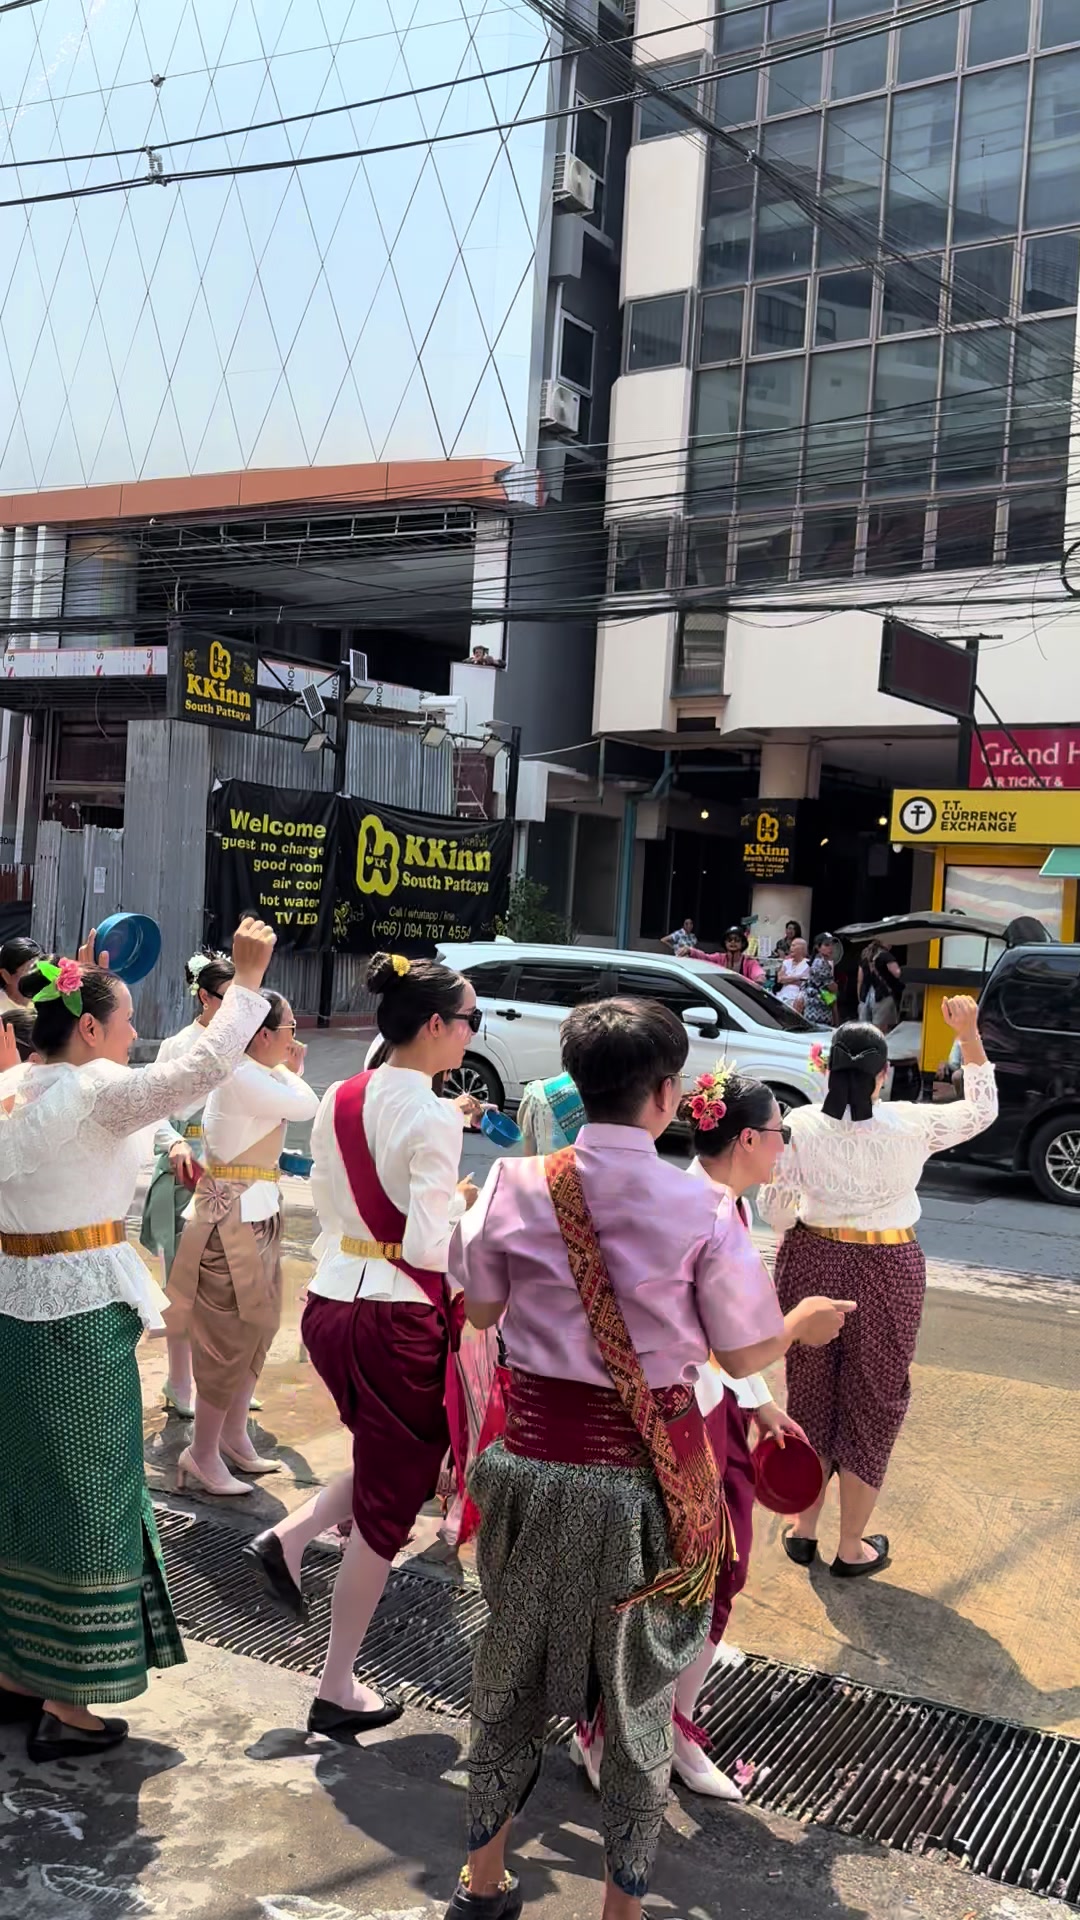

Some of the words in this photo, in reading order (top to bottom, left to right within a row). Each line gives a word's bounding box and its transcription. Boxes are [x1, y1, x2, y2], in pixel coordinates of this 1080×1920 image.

[186, 673, 251, 708] KKinn
[185, 699, 214, 714] South
[216, 704, 251, 721] Pattaya
[981, 742, 1059, 766] Grand
[983, 776, 1005, 788] AR
[1053, 776, 1064, 788] &
[942, 800, 963, 811] T.T.
[229, 808, 327, 839] Welcome
[941, 811, 1017, 822] CURRENCY
[941, 821, 1017, 832] EXCHANGE
[221, 836, 256, 850] guest
[260, 842, 277, 853] no
[281, 842, 325, 859] charge
[403, 834, 491, 872] KKinn
[744, 844, 789, 856] KKinn
[253, 859, 287, 872] good
[289, 862, 323, 873] room
[272, 877, 292, 889] air
[296, 878, 322, 891] cool
[401, 871, 441, 890] South
[444, 876, 489, 895] Pattaya
[260, 892, 280, 906] hot
[284, 895, 320, 908] water
[274, 911, 293, 925] TV
[296, 912, 318, 925] LED
[389, 906, 403, 918] Call
[371, 919, 401, 943] (+66)
[404, 922, 422, 939] 094
[425, 924, 445, 941] 787
[449, 925, 471, 940] 4554
